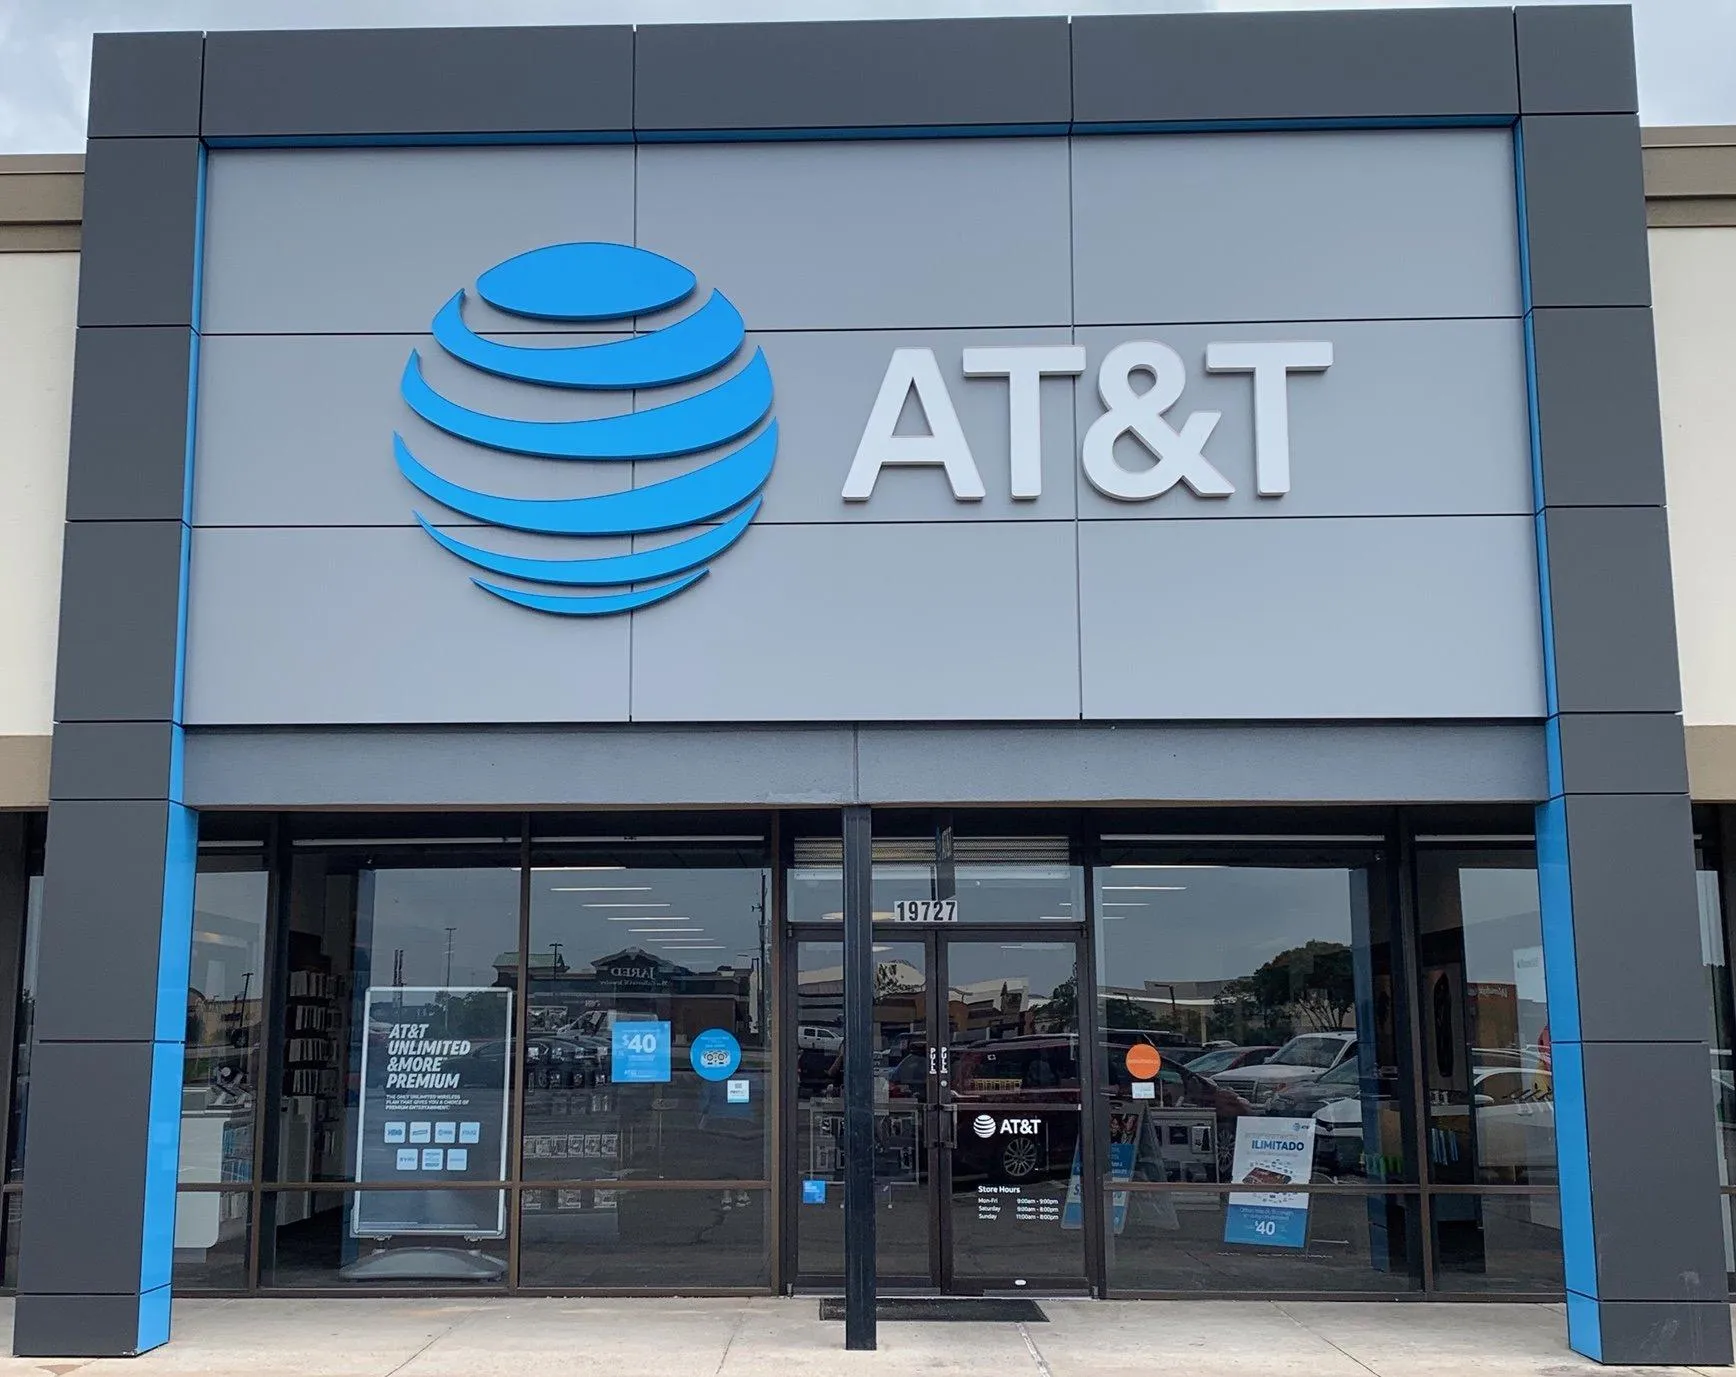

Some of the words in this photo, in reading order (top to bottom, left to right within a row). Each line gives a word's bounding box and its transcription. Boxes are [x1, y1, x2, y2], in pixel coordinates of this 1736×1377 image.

[842, 340, 1334, 501] AT&T
[896, 901, 956, 921] 19727
[389, 1024, 429, 1038] AT&T
[388, 1040, 471, 1055] UNLIMITED
[622, 1033, 657, 1054] $40
[386, 1073, 460, 1088] PREMIUM
[1000, 1119, 1042, 1134] AT&T
[1251, 1140, 1305, 1151] ILIMITADO
[978, 1186, 998, 1194] Store
[999, 1186, 1020, 1194] Hours
[1255, 1221, 1276, 1236] $40
